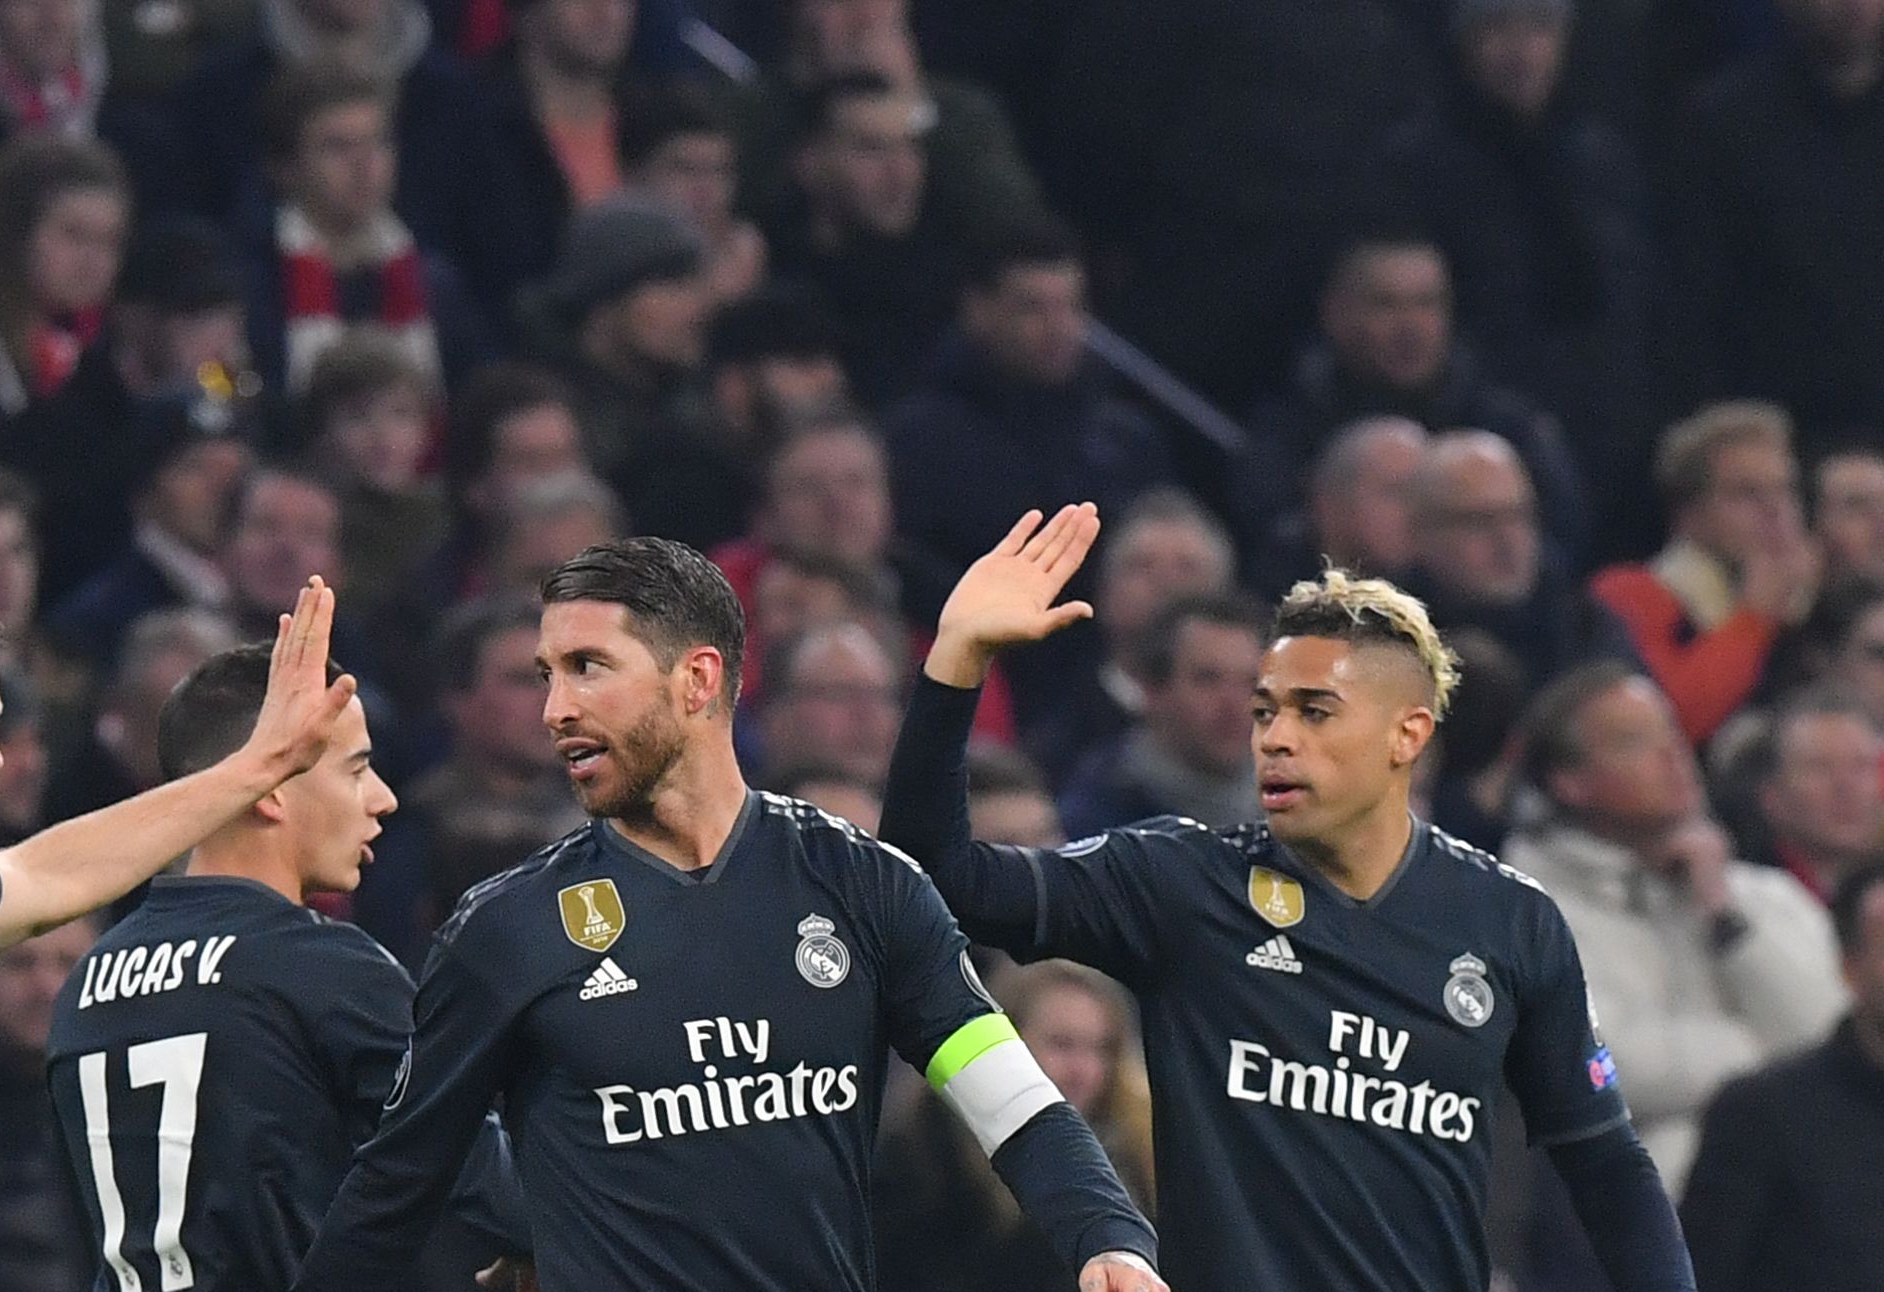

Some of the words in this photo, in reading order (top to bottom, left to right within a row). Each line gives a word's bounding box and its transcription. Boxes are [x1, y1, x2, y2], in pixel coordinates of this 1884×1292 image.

[78, 940, 197, 1010] LUCAS
[198, 935, 237, 985] V.
[579, 978, 638, 1001] adidas
[1246, 952, 1303, 974] adidas
[683, 1017, 770, 1064] Fly
[1329, 1011, 1410, 1070] Fly
[594, 1060, 858, 1144] Emirates
[1227, 1039, 1480, 1143] Emirates
